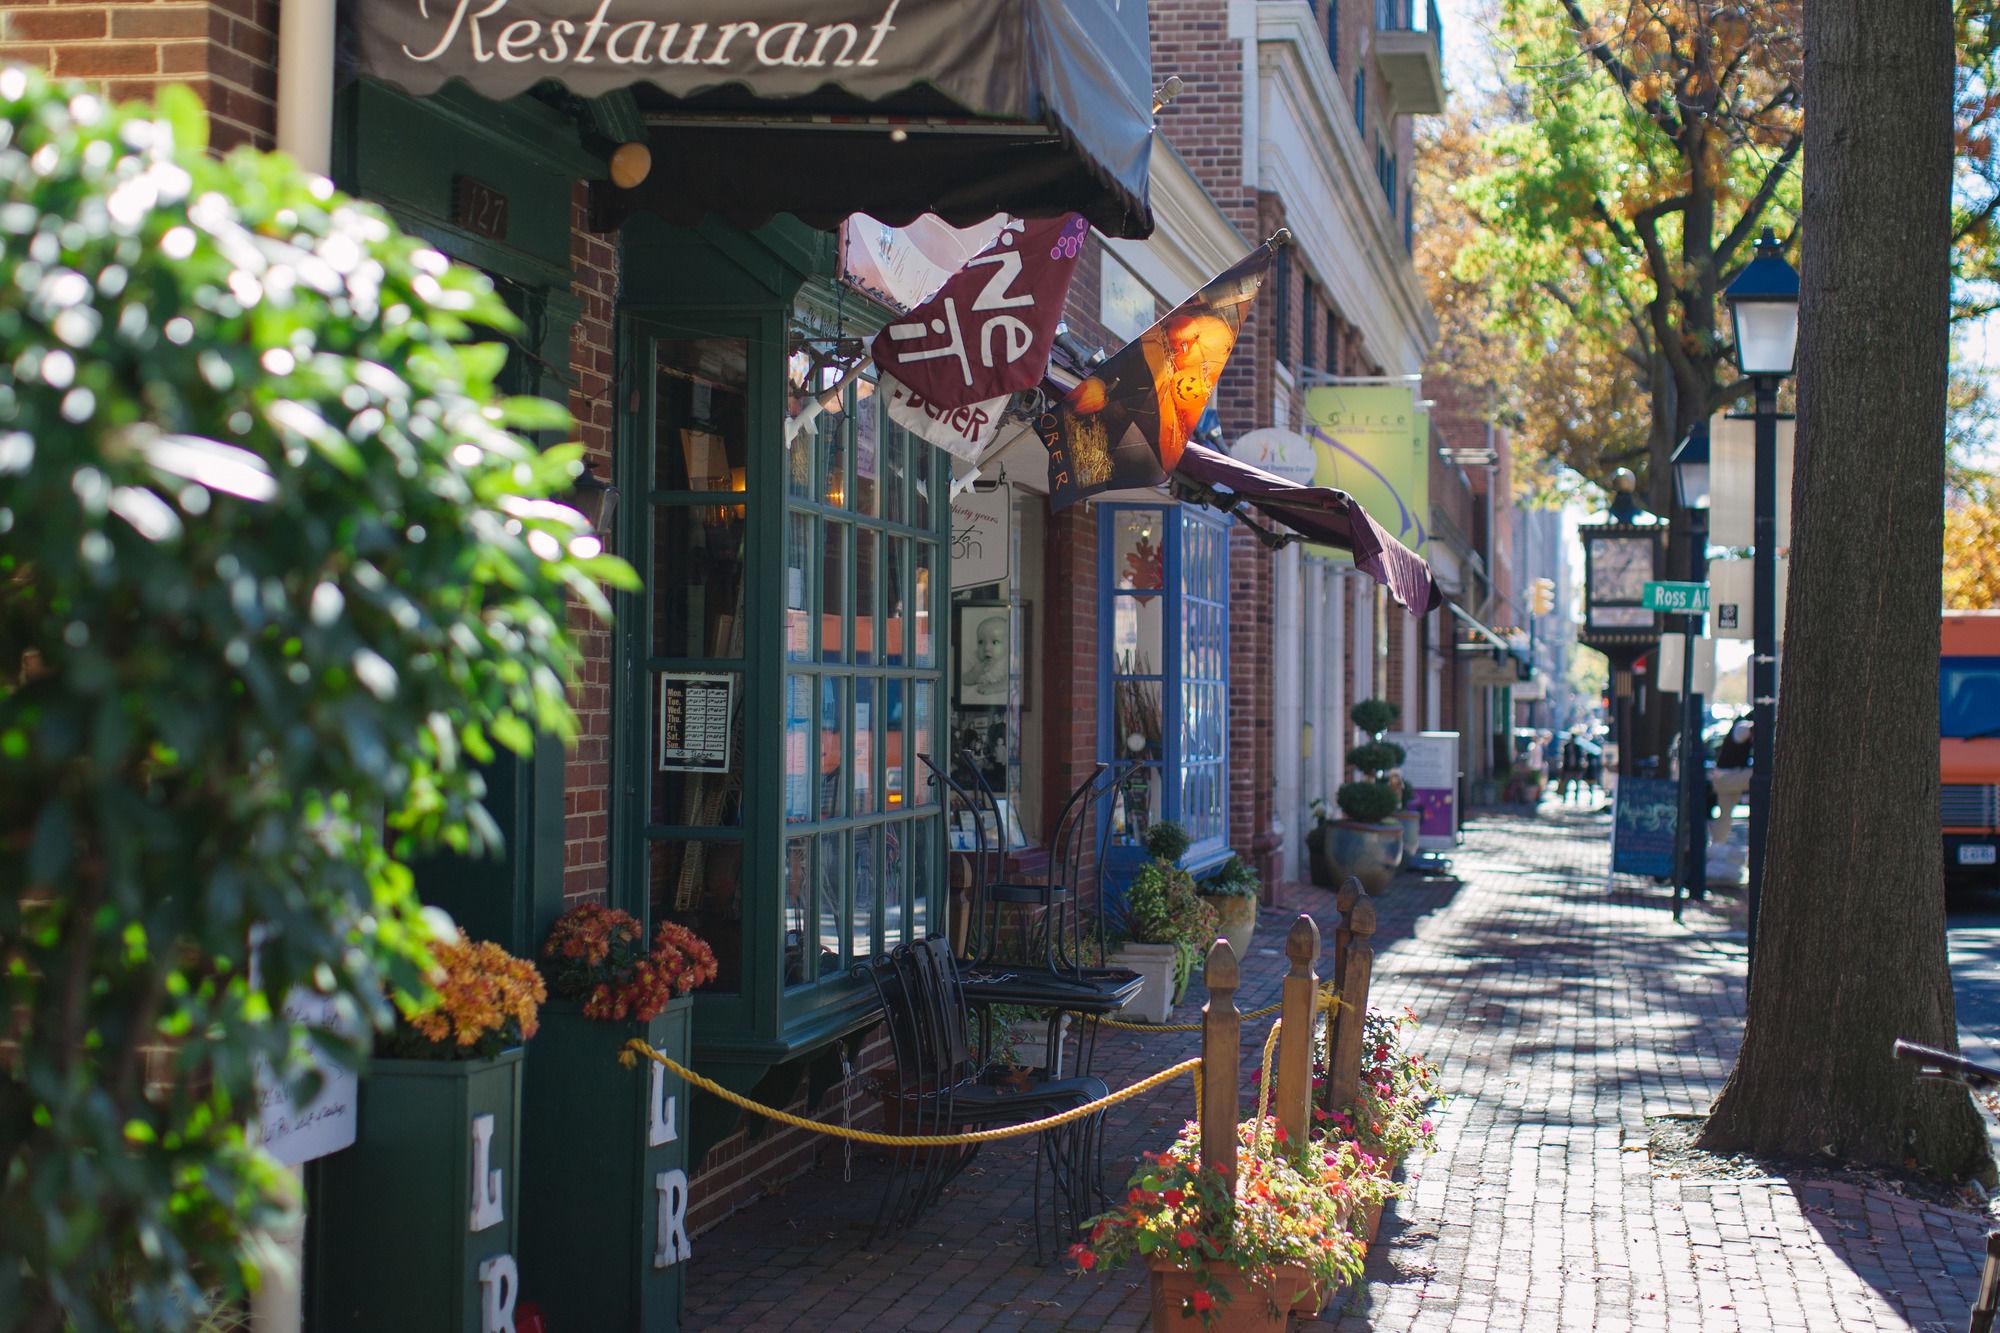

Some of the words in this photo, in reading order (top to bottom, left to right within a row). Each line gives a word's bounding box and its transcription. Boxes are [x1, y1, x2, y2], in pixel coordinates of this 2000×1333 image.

[402, 0, 902, 68] Restaurant
[467, 185, 504, 234] 127
[1655, 586, 1687, 607] Ross
[667, 688, 684, 697] Mon.
[667, 697, 681, 706] Tue.
[667, 706, 682, 715] Wed.
